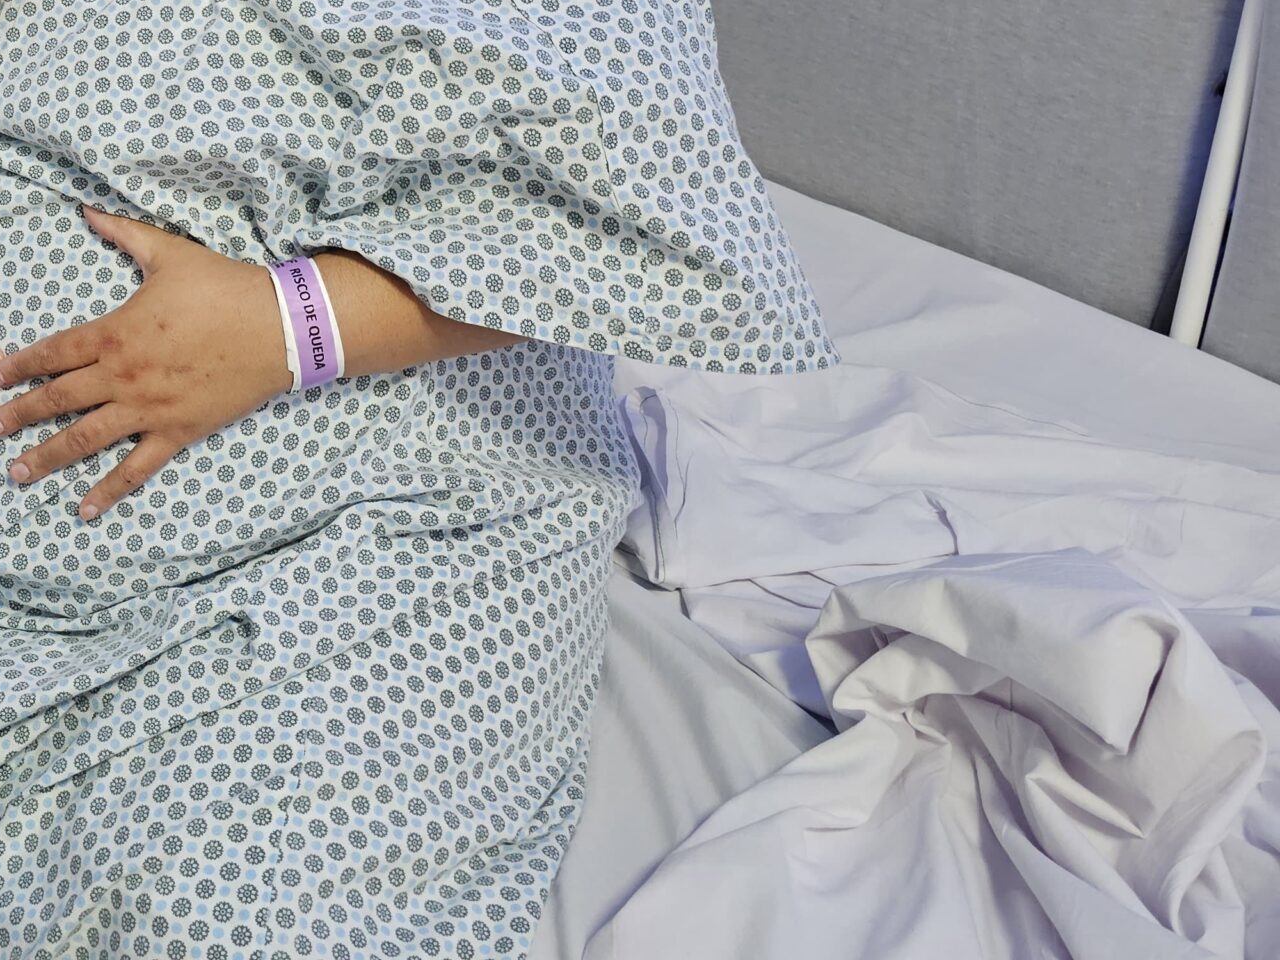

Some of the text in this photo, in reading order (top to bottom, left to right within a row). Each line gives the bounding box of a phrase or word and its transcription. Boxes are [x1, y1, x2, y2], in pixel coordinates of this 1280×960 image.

[289, 267, 326, 371] RISCO DE QUEDA
